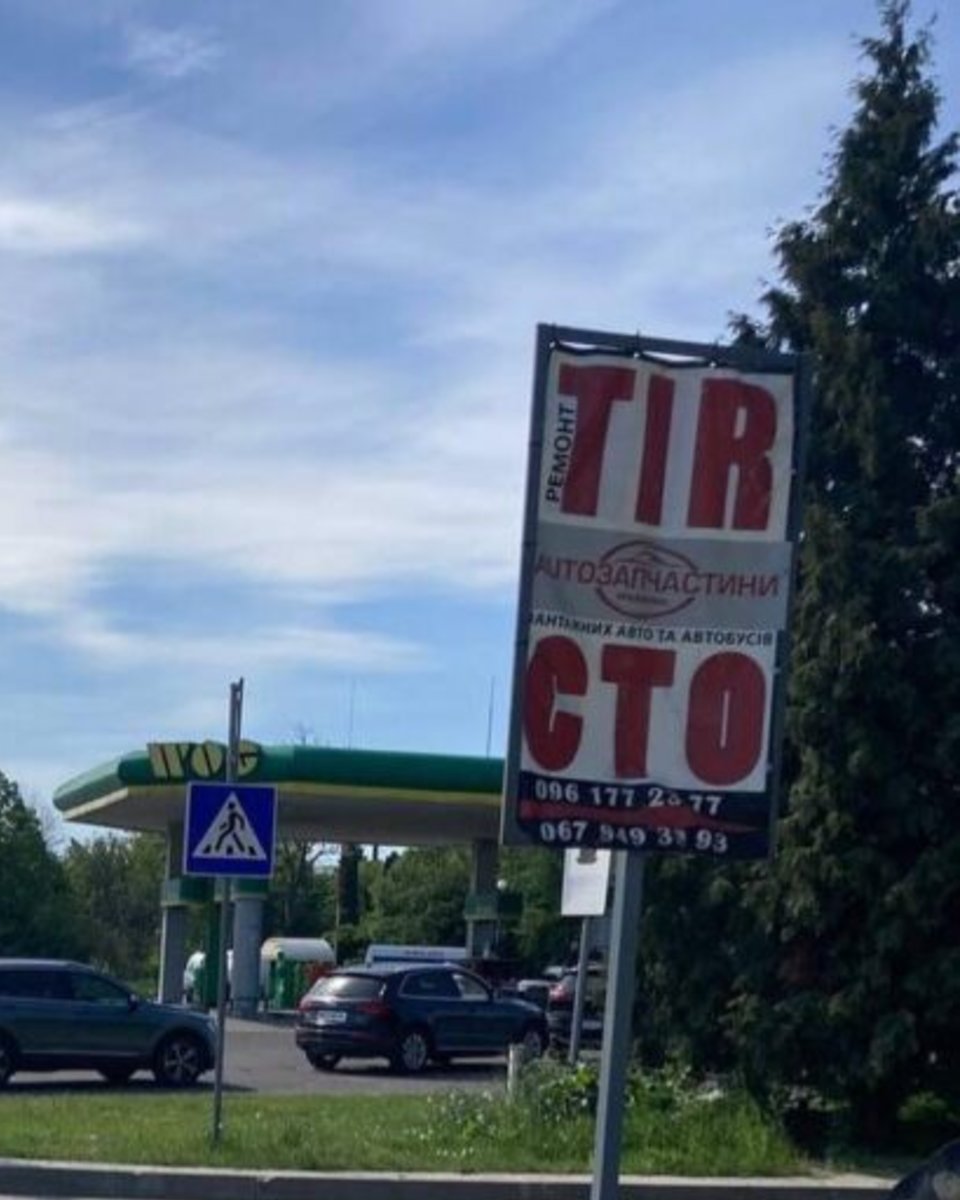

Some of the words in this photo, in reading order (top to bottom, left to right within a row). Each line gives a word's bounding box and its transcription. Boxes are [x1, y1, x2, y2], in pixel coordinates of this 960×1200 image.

[545, 402, 575, 502] РЕМОНТ
[557, 362, 778, 532] TIR
[616, 624, 654, 641] АВТО
[659, 629, 677, 643] ТА
[522, 635, 767, 786] СТО
[146, 740, 262, 779] WOG
[535, 780, 579, 802] 096
[590, 787, 636, 807] 177
[689, 793, 722, 816] 77
[541, 820, 588, 842] 067
[696, 829, 728, 854] 93
